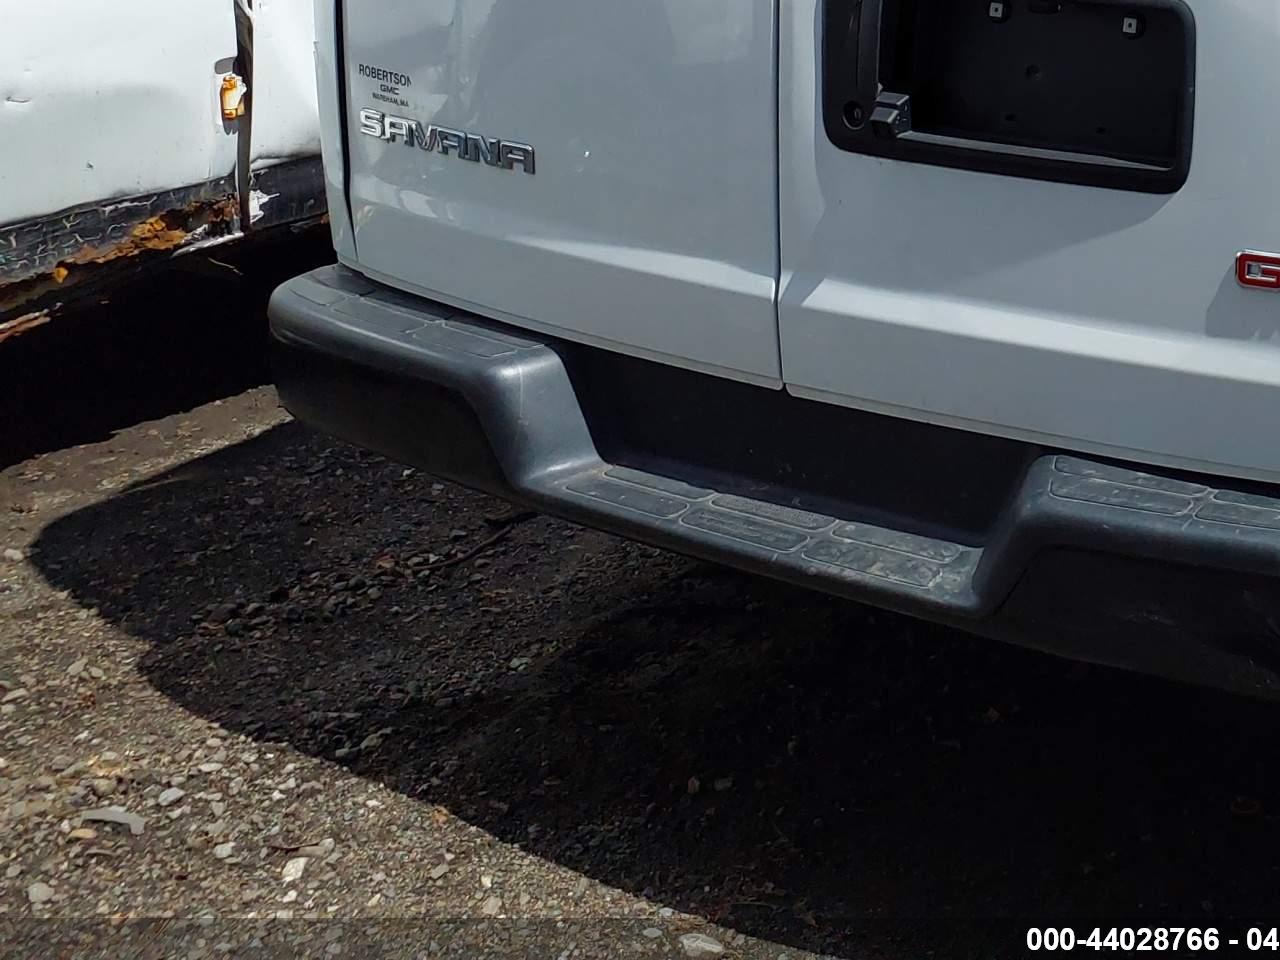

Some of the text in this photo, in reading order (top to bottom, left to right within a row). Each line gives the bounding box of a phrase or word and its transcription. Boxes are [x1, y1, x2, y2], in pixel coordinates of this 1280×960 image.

[359, 63, 412, 87] ROBERTSON
[380, 83, 400, 96] GMC
[359, 107, 536, 175] SAVANA
